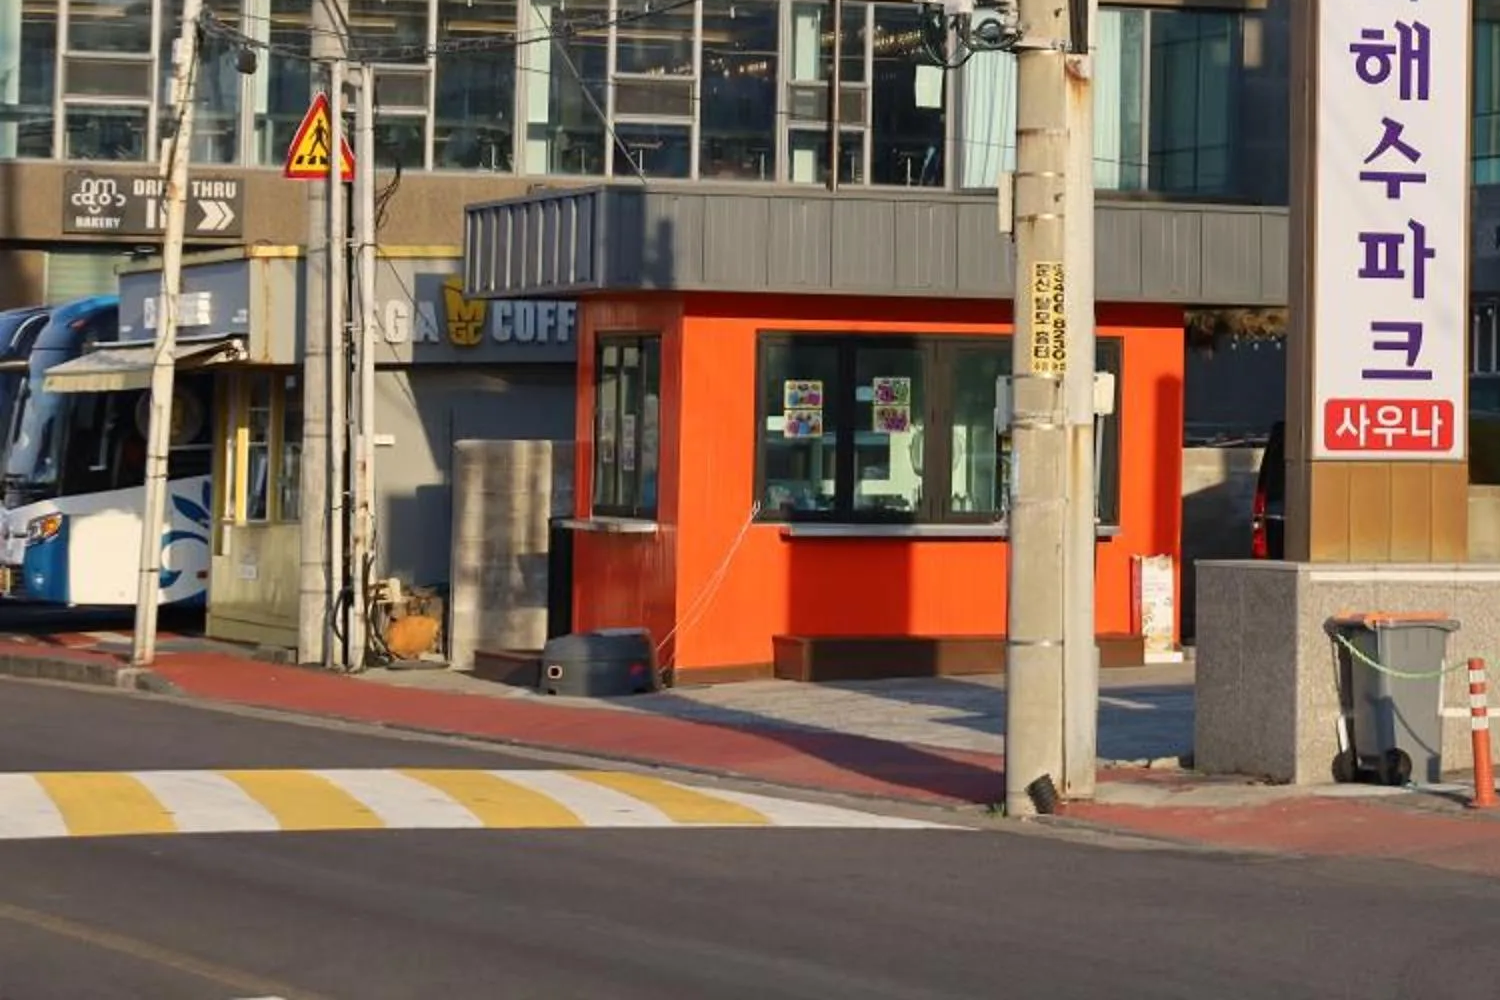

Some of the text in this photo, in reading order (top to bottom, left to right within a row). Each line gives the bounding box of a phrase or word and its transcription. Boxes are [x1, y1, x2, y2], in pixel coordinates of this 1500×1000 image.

[191, 181, 237, 199] THRU
[1348, 19, 1437, 381] 해수파크
[75, 216, 121, 229] BAKERY
[493, 301, 578, 342] COFF
[1335, 404, 1444, 448] 사우나
